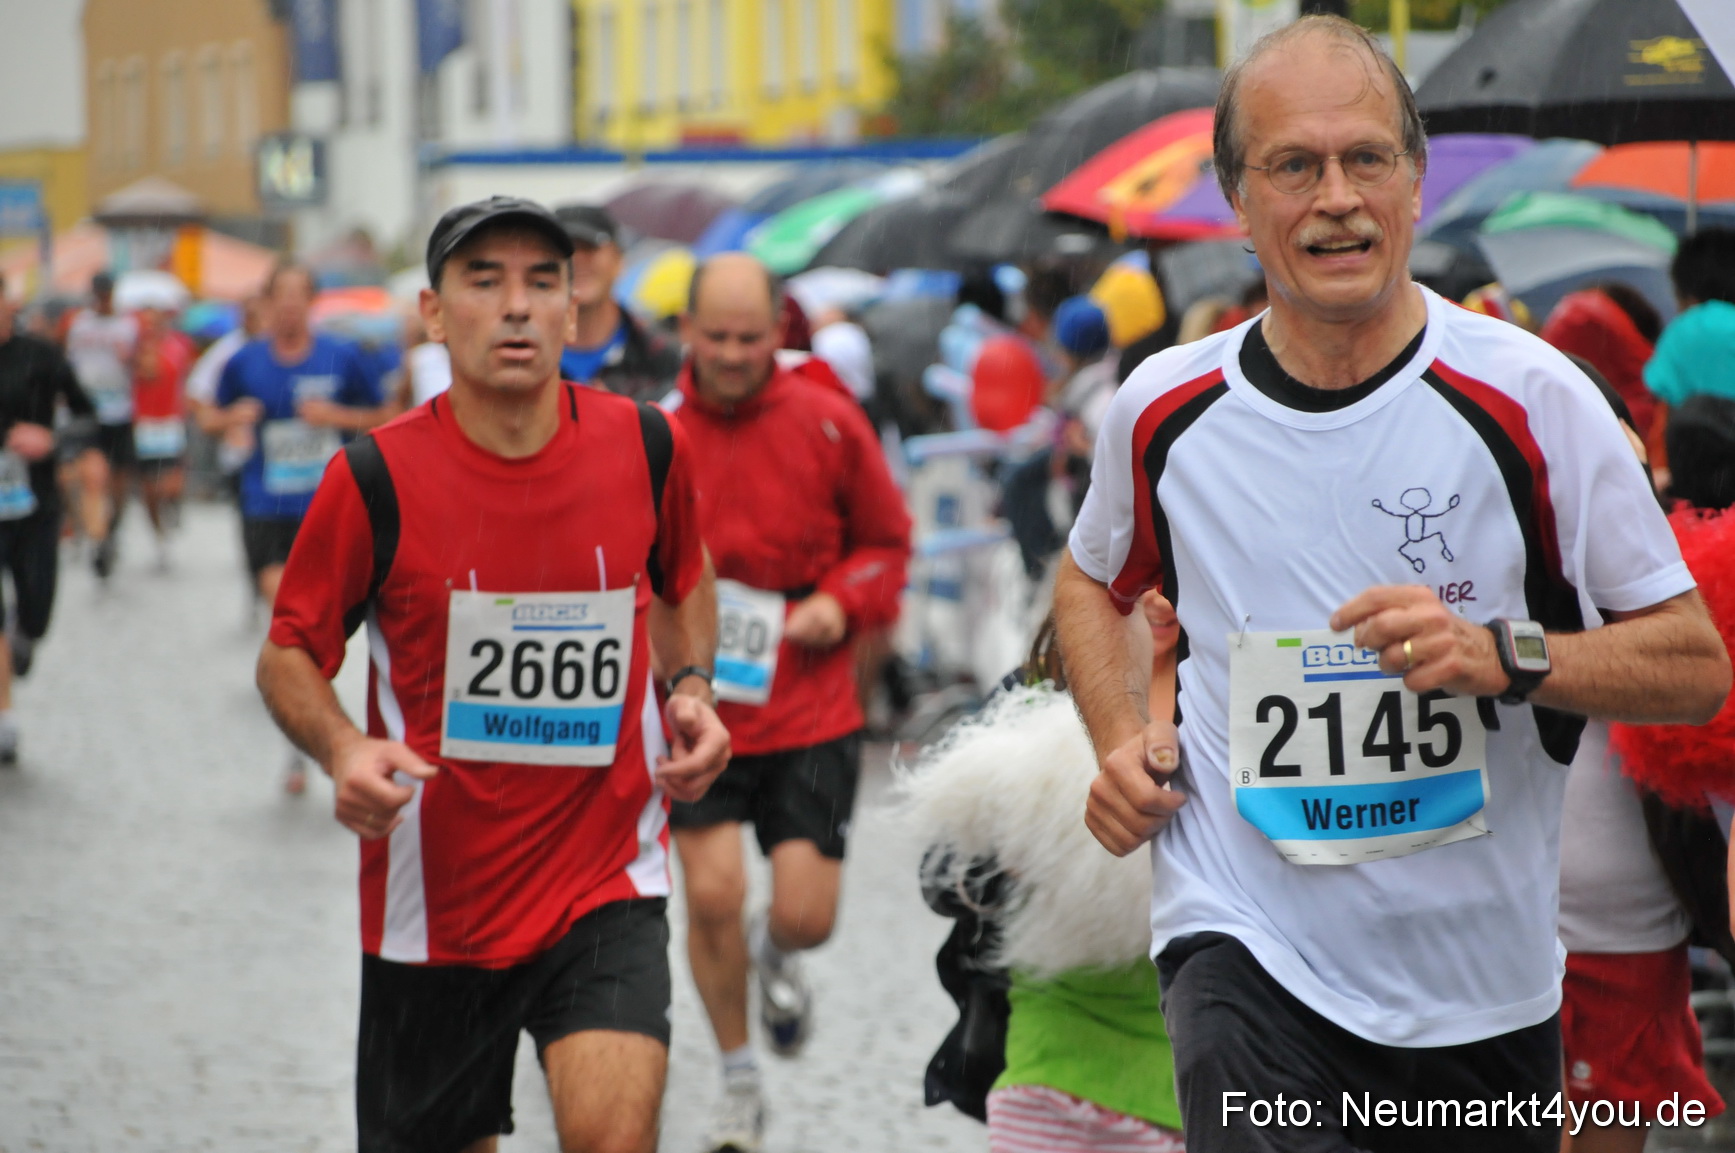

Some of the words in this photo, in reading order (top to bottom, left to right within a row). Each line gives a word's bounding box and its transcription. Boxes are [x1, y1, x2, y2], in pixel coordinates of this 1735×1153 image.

[511, 602, 588, 621] BOCK
[466, 637, 621, 700] 2666
[1302, 643, 1380, 668] BOC
[483, 711, 601, 746] Wolfgang
[1255, 687, 1463, 778] 2145
[1300, 797, 1420, 831] Werner
